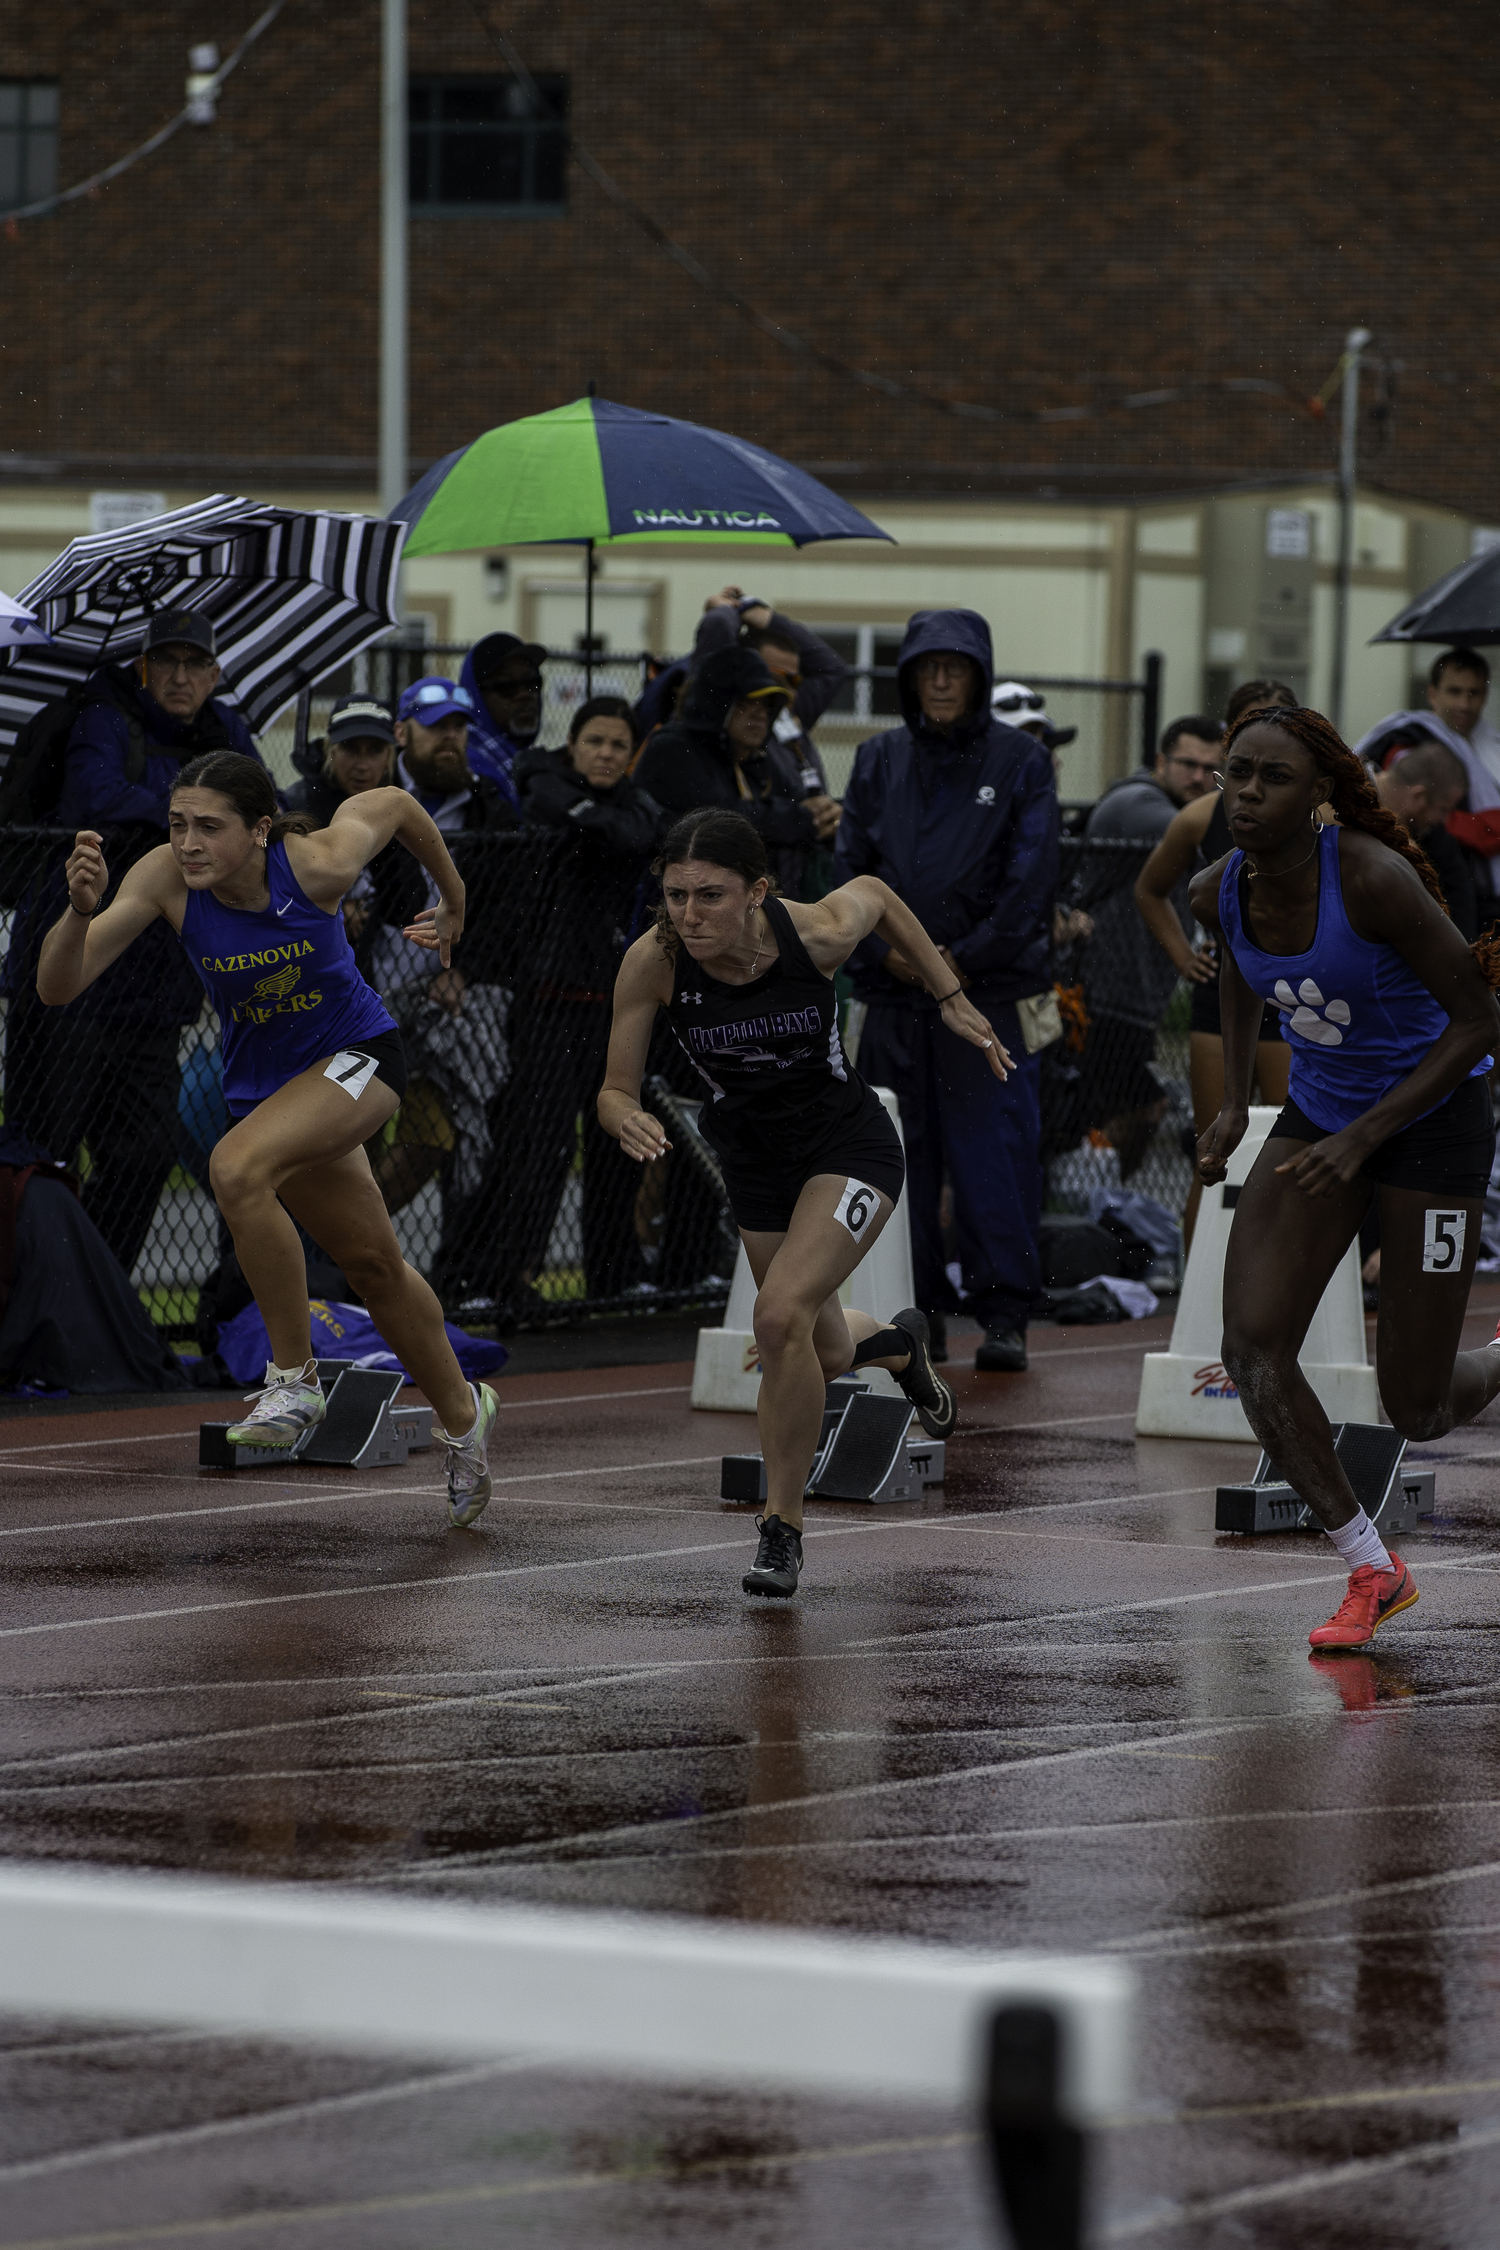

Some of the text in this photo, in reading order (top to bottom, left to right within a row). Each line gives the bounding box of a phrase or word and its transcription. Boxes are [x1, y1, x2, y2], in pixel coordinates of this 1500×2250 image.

[632, 508, 782, 528] NAUTICA
[202, 939, 316, 972] CAZENOVIA
[688, 1006, 822, 1052] HAMPTON BAYS
[335, 1052, 371, 1084] 7
[846, 1187, 875, 1233] 6
[1432, 1213, 1458, 1270] 5
